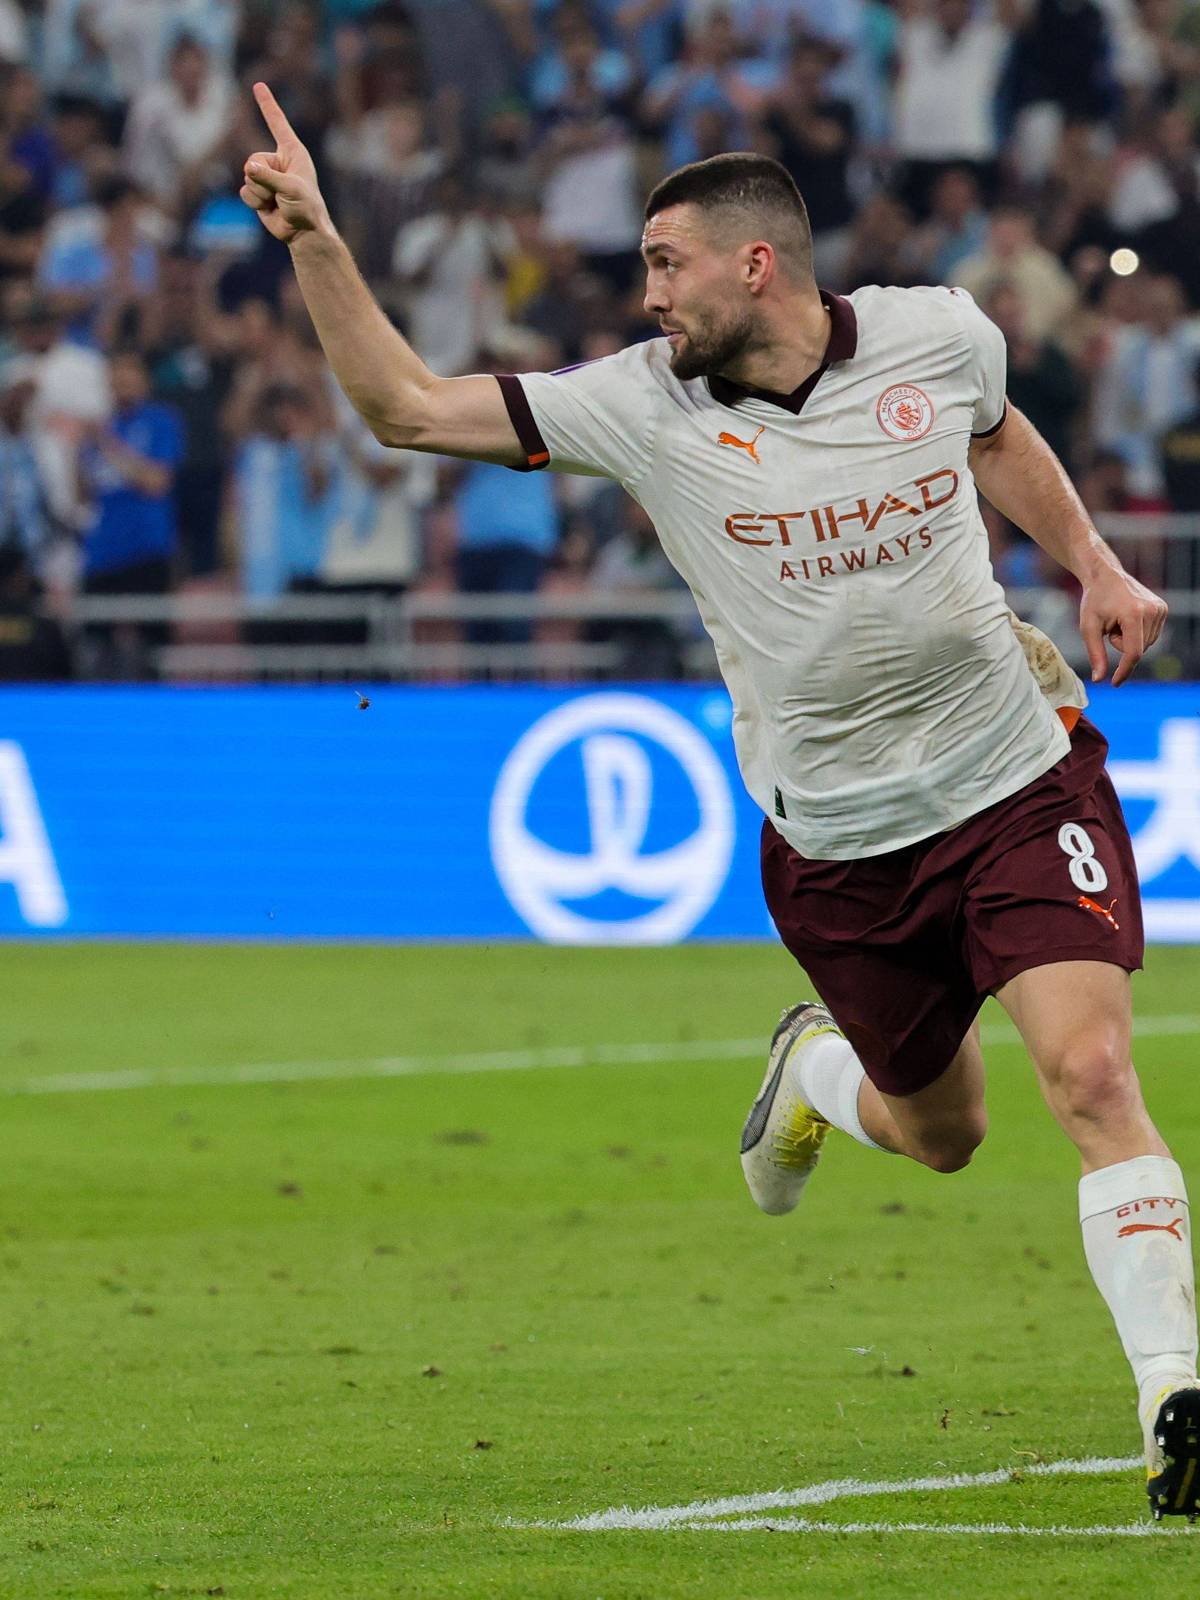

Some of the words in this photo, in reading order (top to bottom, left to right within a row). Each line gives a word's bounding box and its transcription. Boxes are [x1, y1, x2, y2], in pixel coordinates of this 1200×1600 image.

[724, 469, 959, 546] ETIHAD
[779, 526, 933, 582] AIRWAYS
[1058, 822, 1108, 892] 8
[1116, 1198, 1177, 1218] CITY
